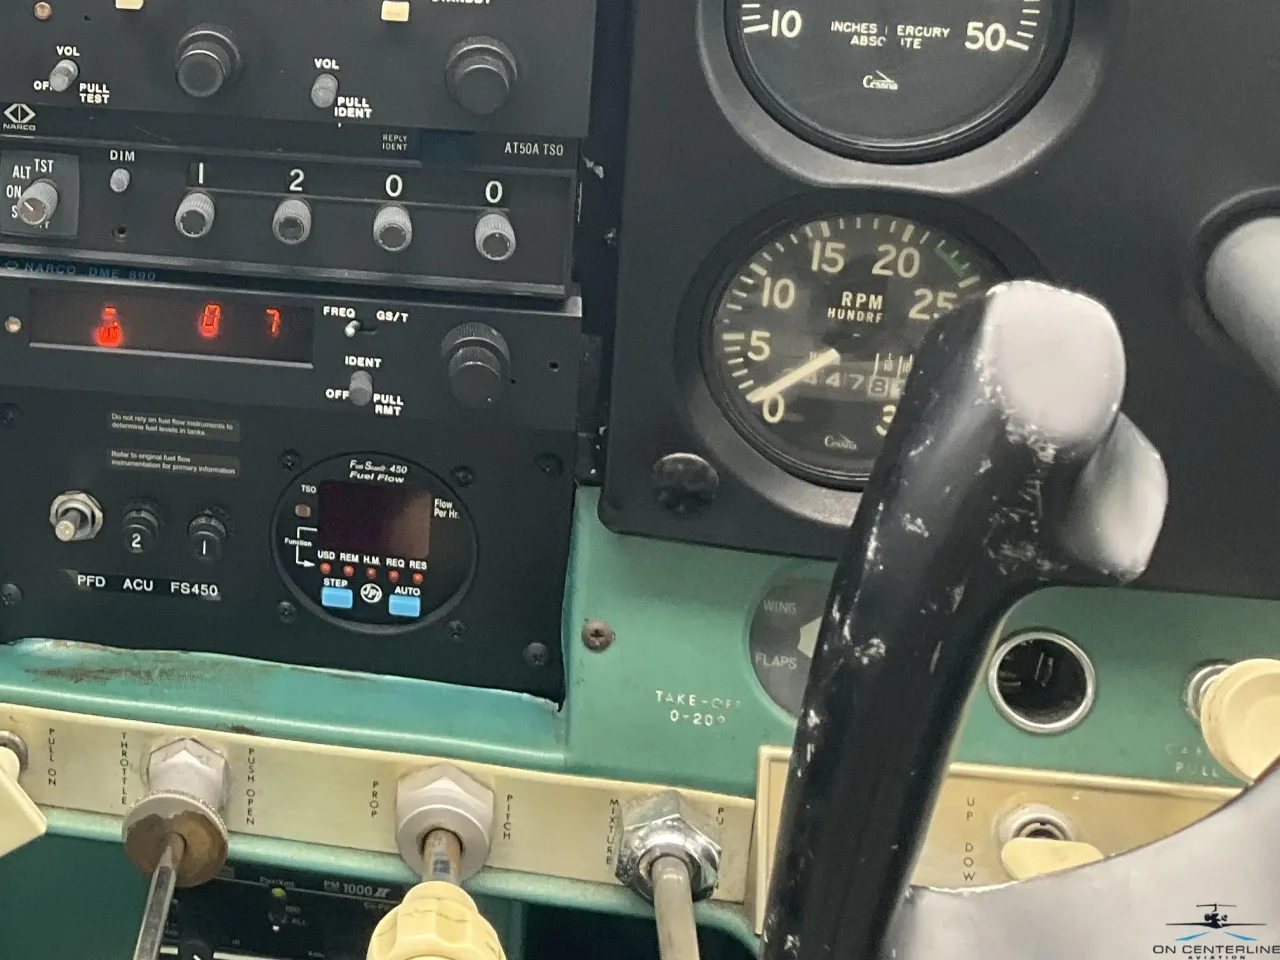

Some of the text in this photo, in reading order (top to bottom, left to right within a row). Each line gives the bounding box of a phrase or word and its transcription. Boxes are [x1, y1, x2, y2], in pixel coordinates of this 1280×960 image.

[771, 10, 801, 37] 10
[831, 21, 877, 34] INCHES
[965, 22, 1006, 52] 50
[56, 46, 80, 56] VOL
[314, 58, 339, 70] VOL
[80, 83, 109, 94] PULL
[80, 93, 109, 104] TEST
[337, 97, 369, 108] PULL
[334, 107, 372, 118] IDENT
[3, 123, 36, 131] NARCO
[383, 134, 407, 142] REPLY
[382, 143, 407, 151] IDENT
[505, 142, 563, 156] AT50A TSO
[110, 150, 135, 161] DIM
[34, 159, 54, 172] TST
[12, 166, 31, 179] ALT
[811, 240, 845, 273] 15
[872, 244, 920, 278] 20
[841, 291, 883, 310] RPM
[323, 306, 356, 319] FREQ
[376, 310, 409, 322] GS/T
[345, 356, 382, 368] IDENT
[326, 388, 349, 400] OFF
[373, 394, 404, 406] PULL
[375, 404, 402, 416] RMT
[389, 465, 407, 474] 450
[350, 471, 404, 483] Fuel Flow
[340, 553, 427, 570] REM REQ RES
[77, 575, 106, 589] PFD
[123, 578, 154, 592] ACU
[323, 578, 348, 587] STEP
[170, 581, 218, 597] FS450
[395, 586, 420, 595] AUTO
[763, 600, 796, 614] WING
[755, 652, 797, 669] FLAPS
